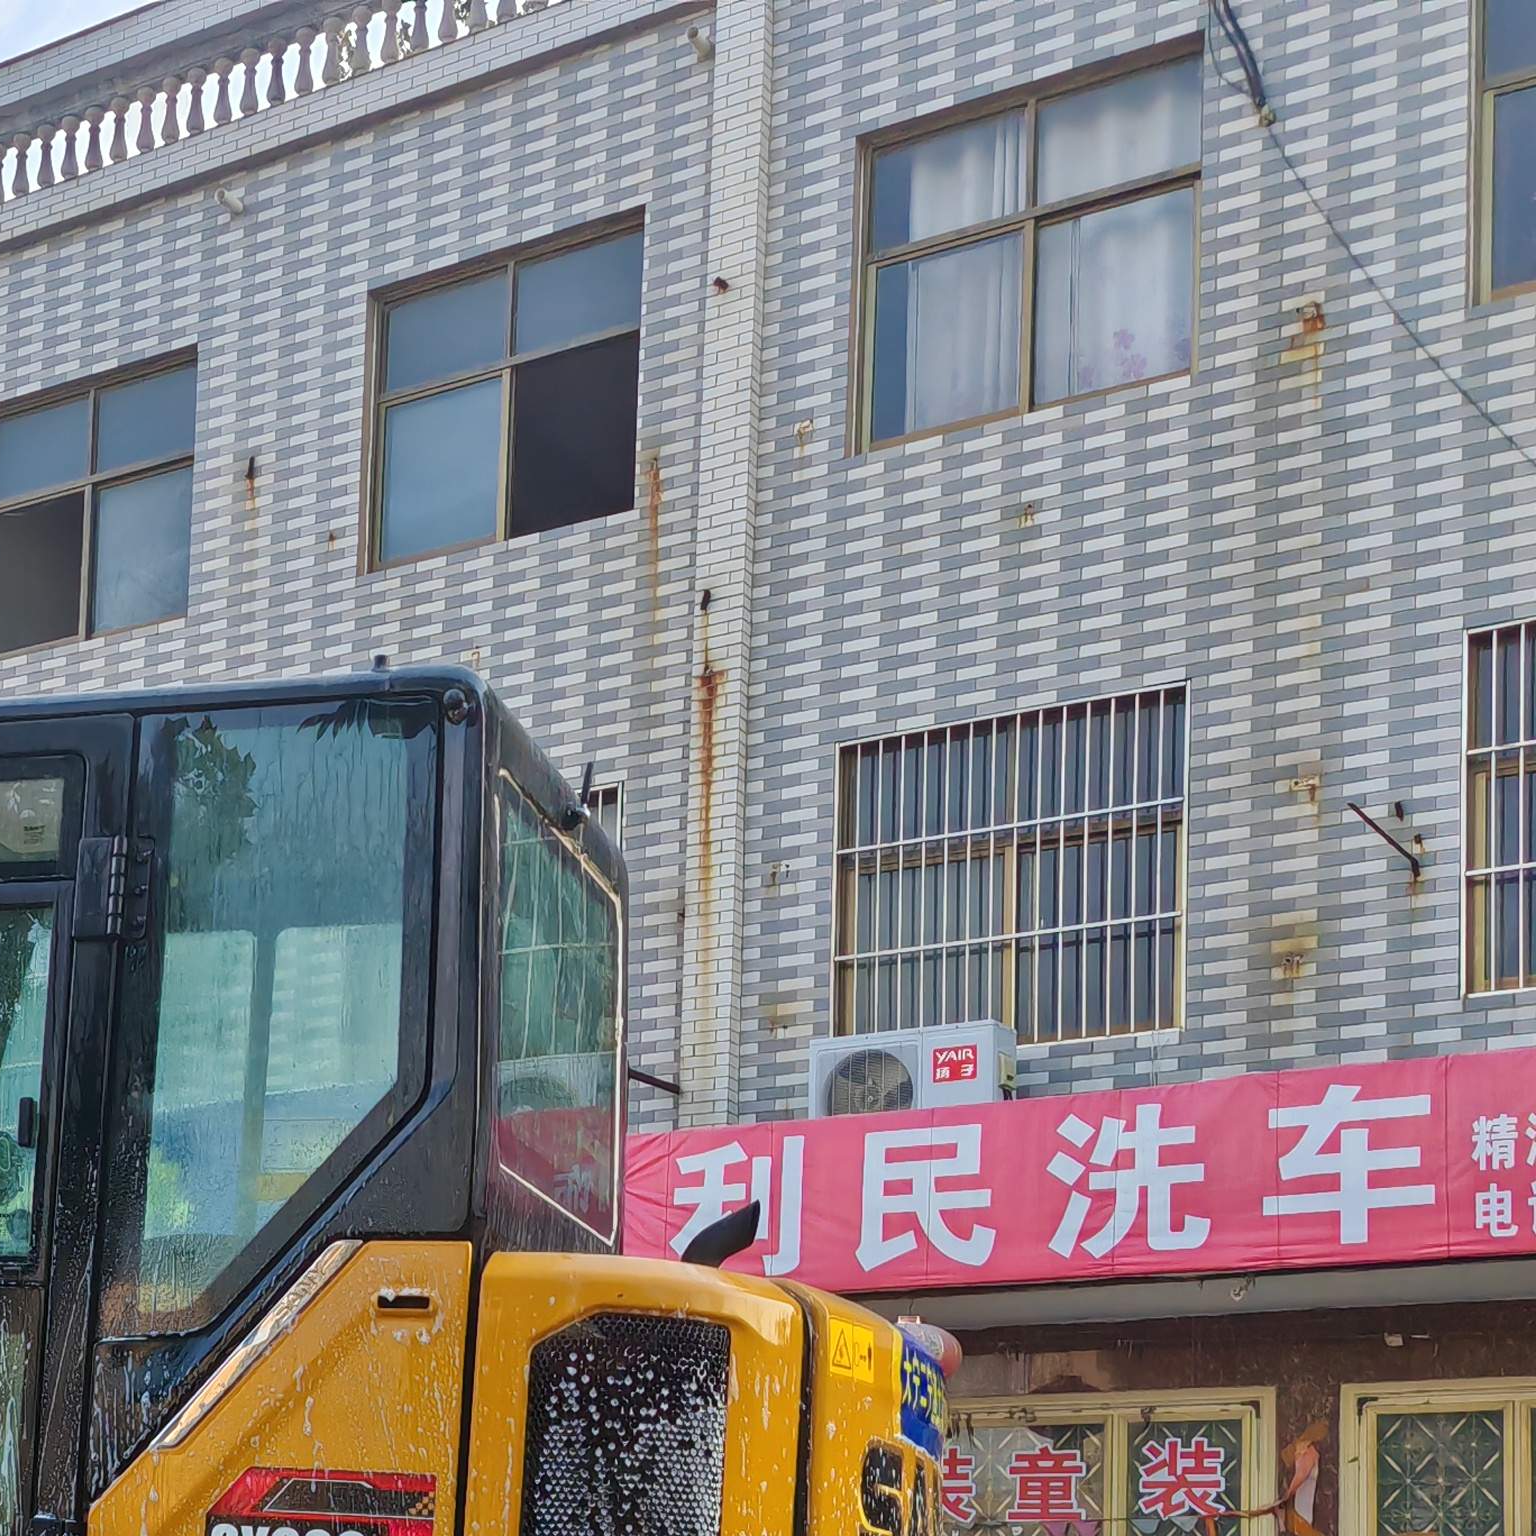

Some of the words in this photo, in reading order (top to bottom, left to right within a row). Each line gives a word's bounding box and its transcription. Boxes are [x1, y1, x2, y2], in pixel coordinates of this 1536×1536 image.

[936, 1048, 974, 1065] YAIR
[668, 1084, 1436, 1277] 利民洗车
